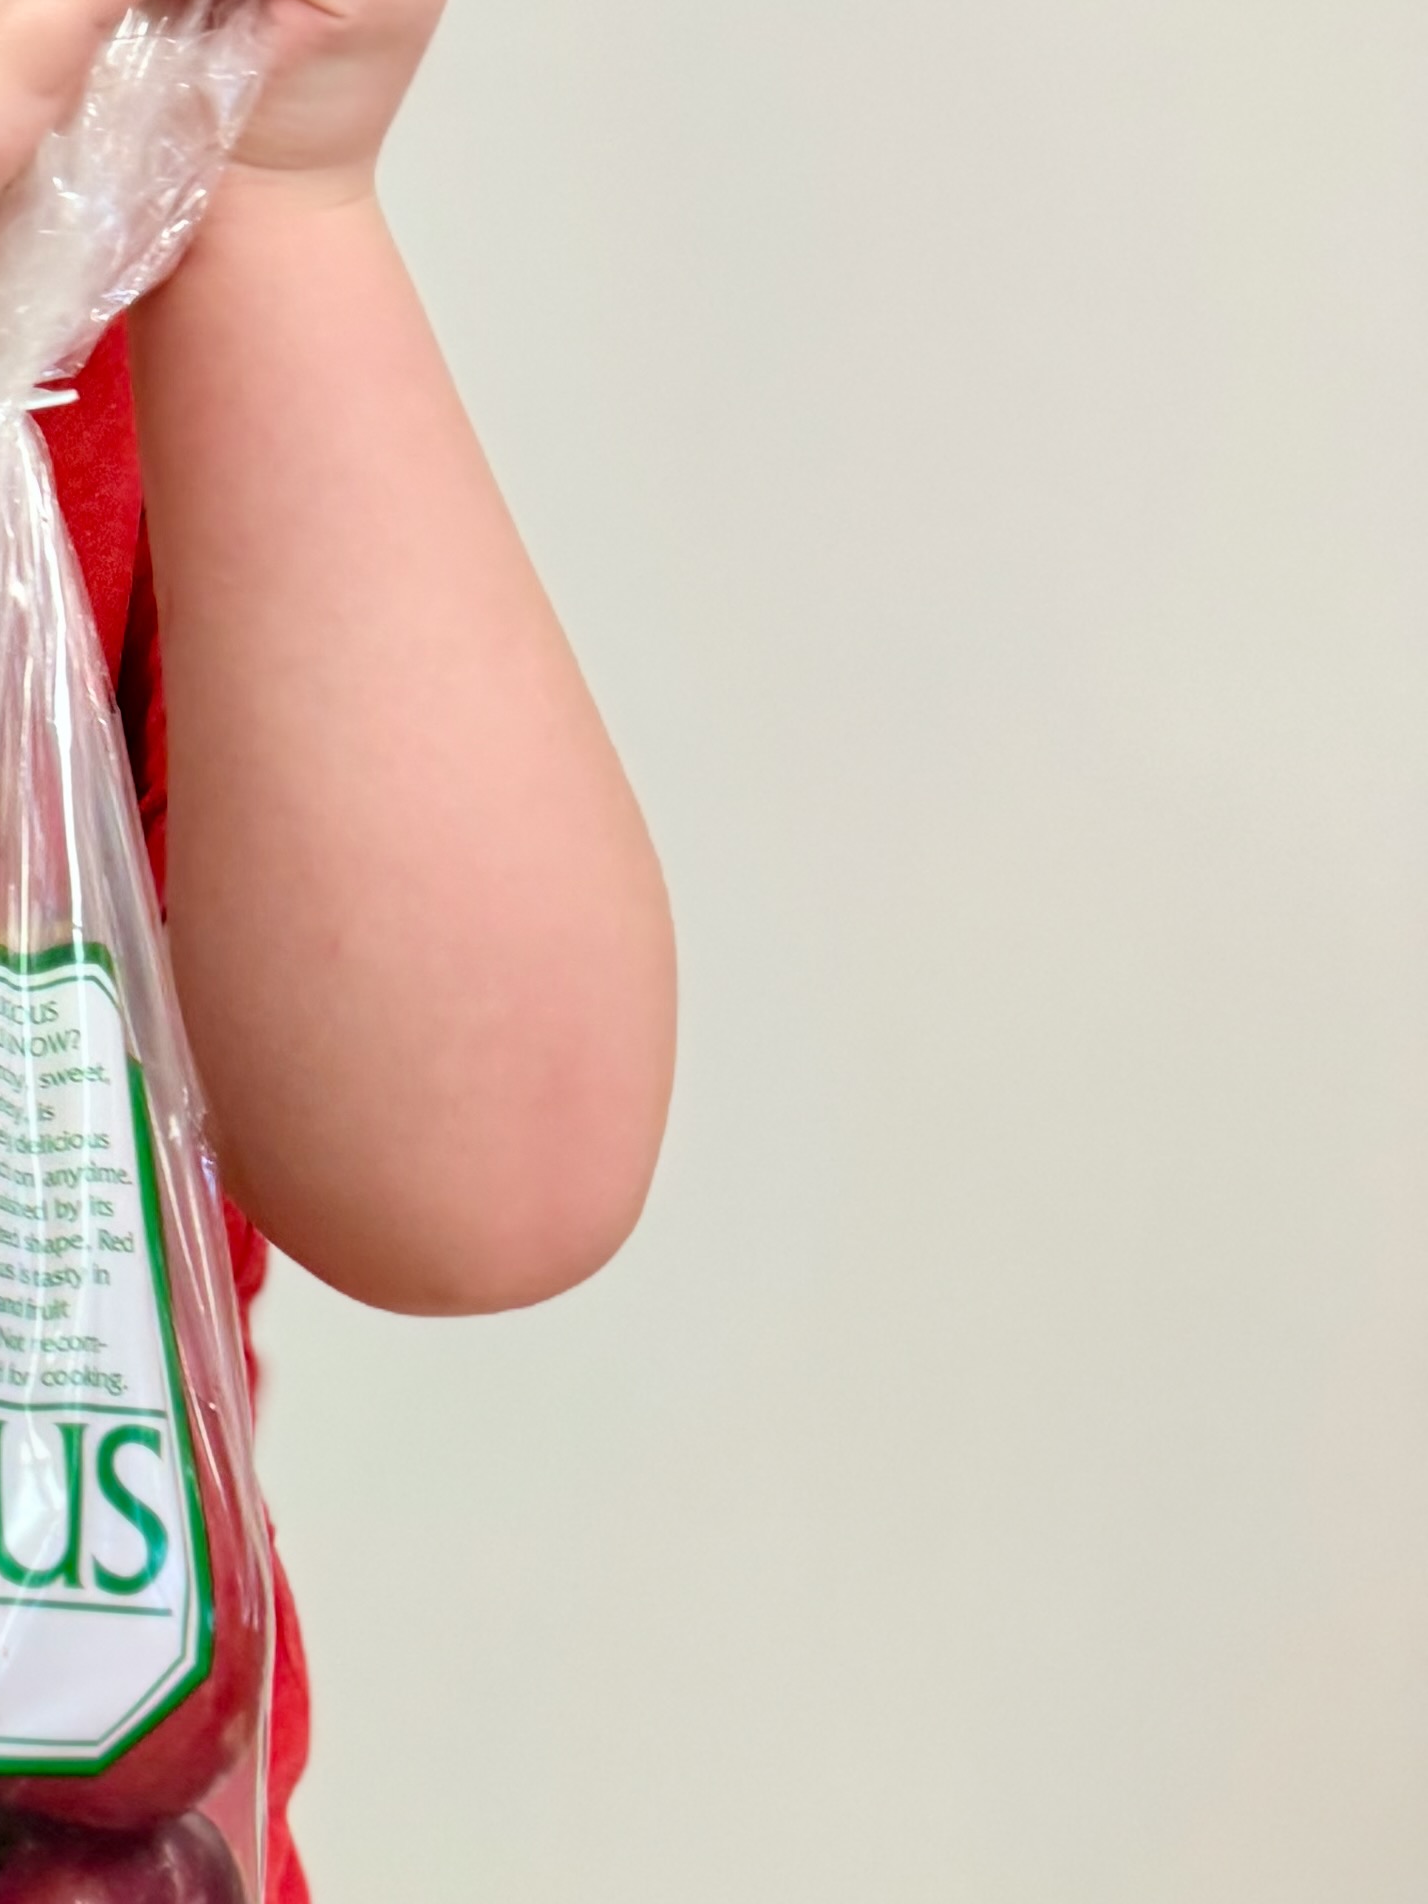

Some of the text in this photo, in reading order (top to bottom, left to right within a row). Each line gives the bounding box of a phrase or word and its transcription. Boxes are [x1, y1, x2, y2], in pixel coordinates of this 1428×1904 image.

[53, 1199, 79, 1222] by
[96, 1228, 135, 1253] Red
[92, 1263, 111, 1286] in
[40, 1367, 129, 1396] cooking.
